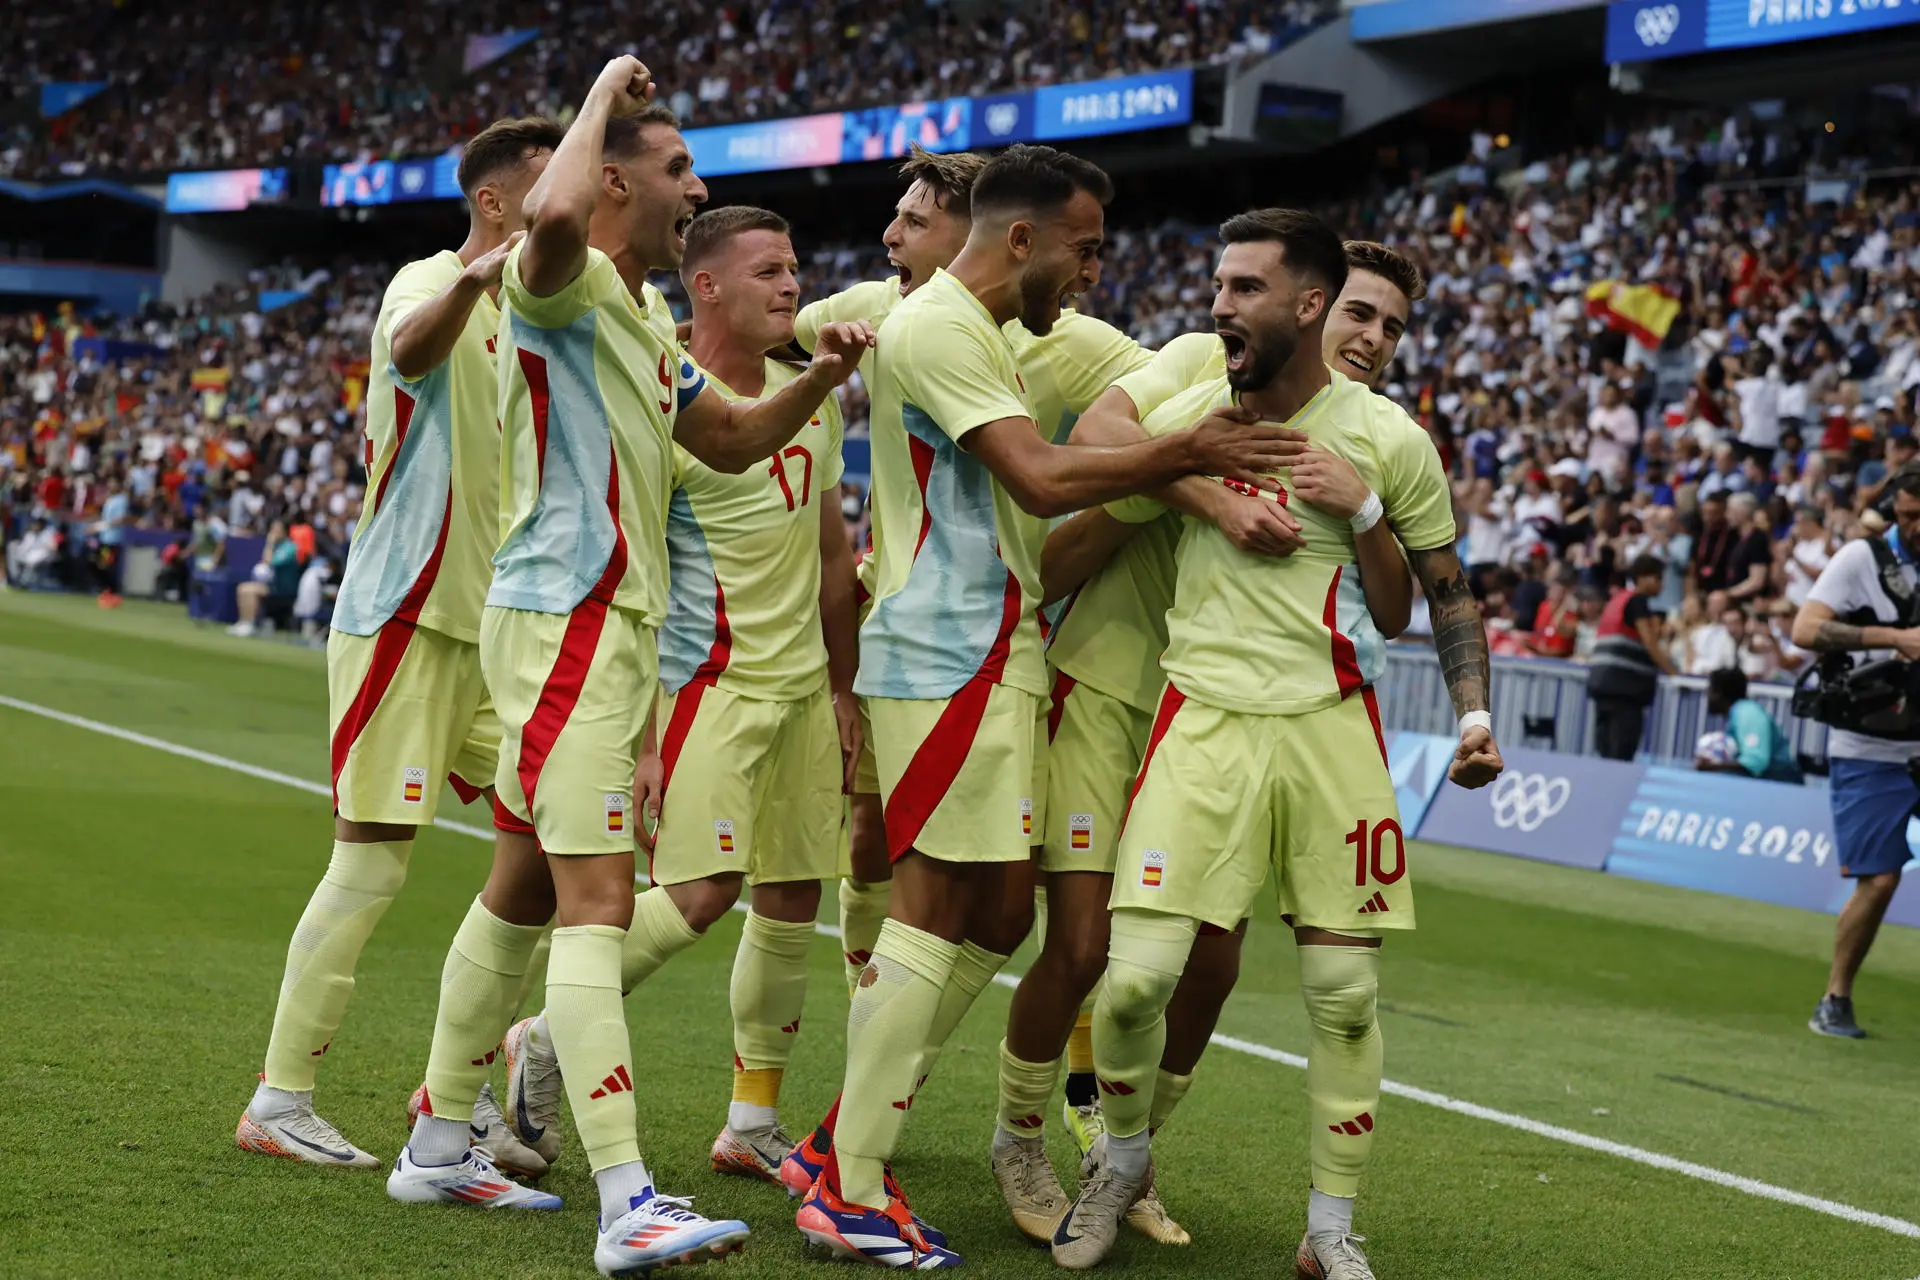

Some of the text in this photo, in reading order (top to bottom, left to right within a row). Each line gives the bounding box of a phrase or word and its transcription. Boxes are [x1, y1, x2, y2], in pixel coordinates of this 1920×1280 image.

[768, 445, 813, 512] 17
[1345, 817, 1406, 886] 10
[1636, 806, 1832, 867] PARIS 2024
